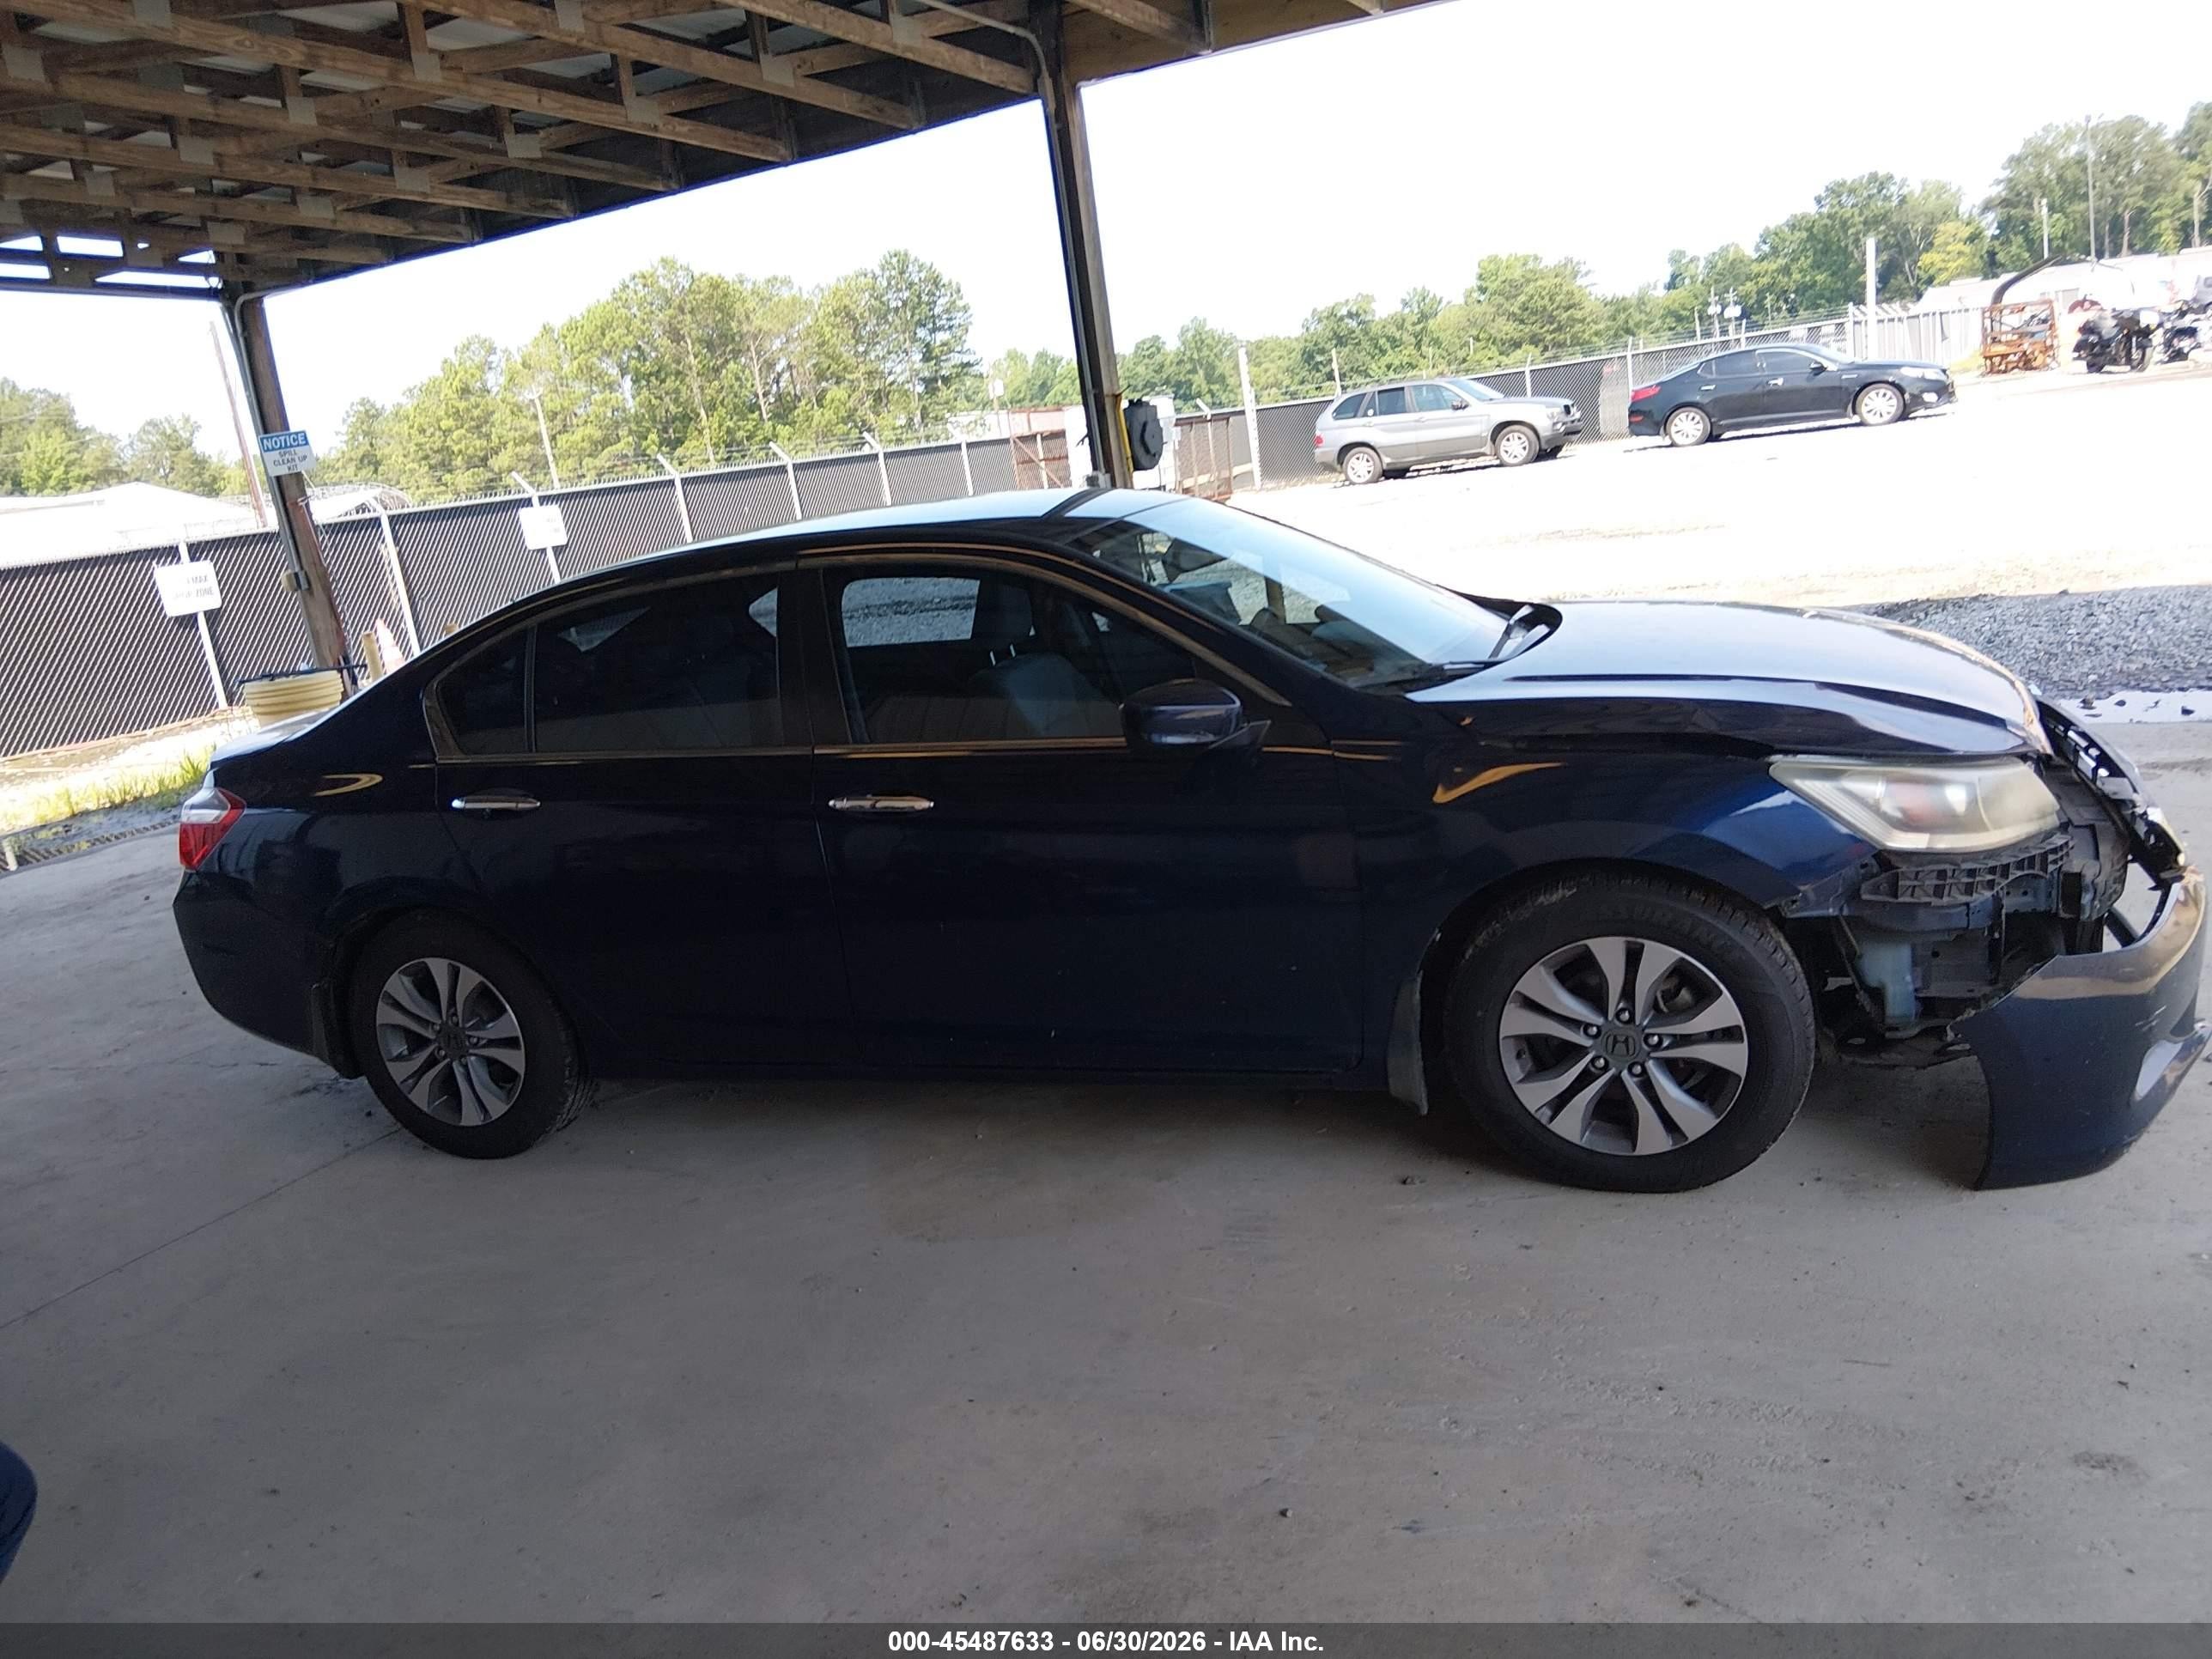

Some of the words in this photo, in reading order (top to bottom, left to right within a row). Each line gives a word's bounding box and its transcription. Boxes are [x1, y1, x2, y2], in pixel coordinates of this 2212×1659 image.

[263, 433, 306, 451] NOTICE
[273, 456, 296, 467] CLEAN
[298, 454, 307, 463] UP
